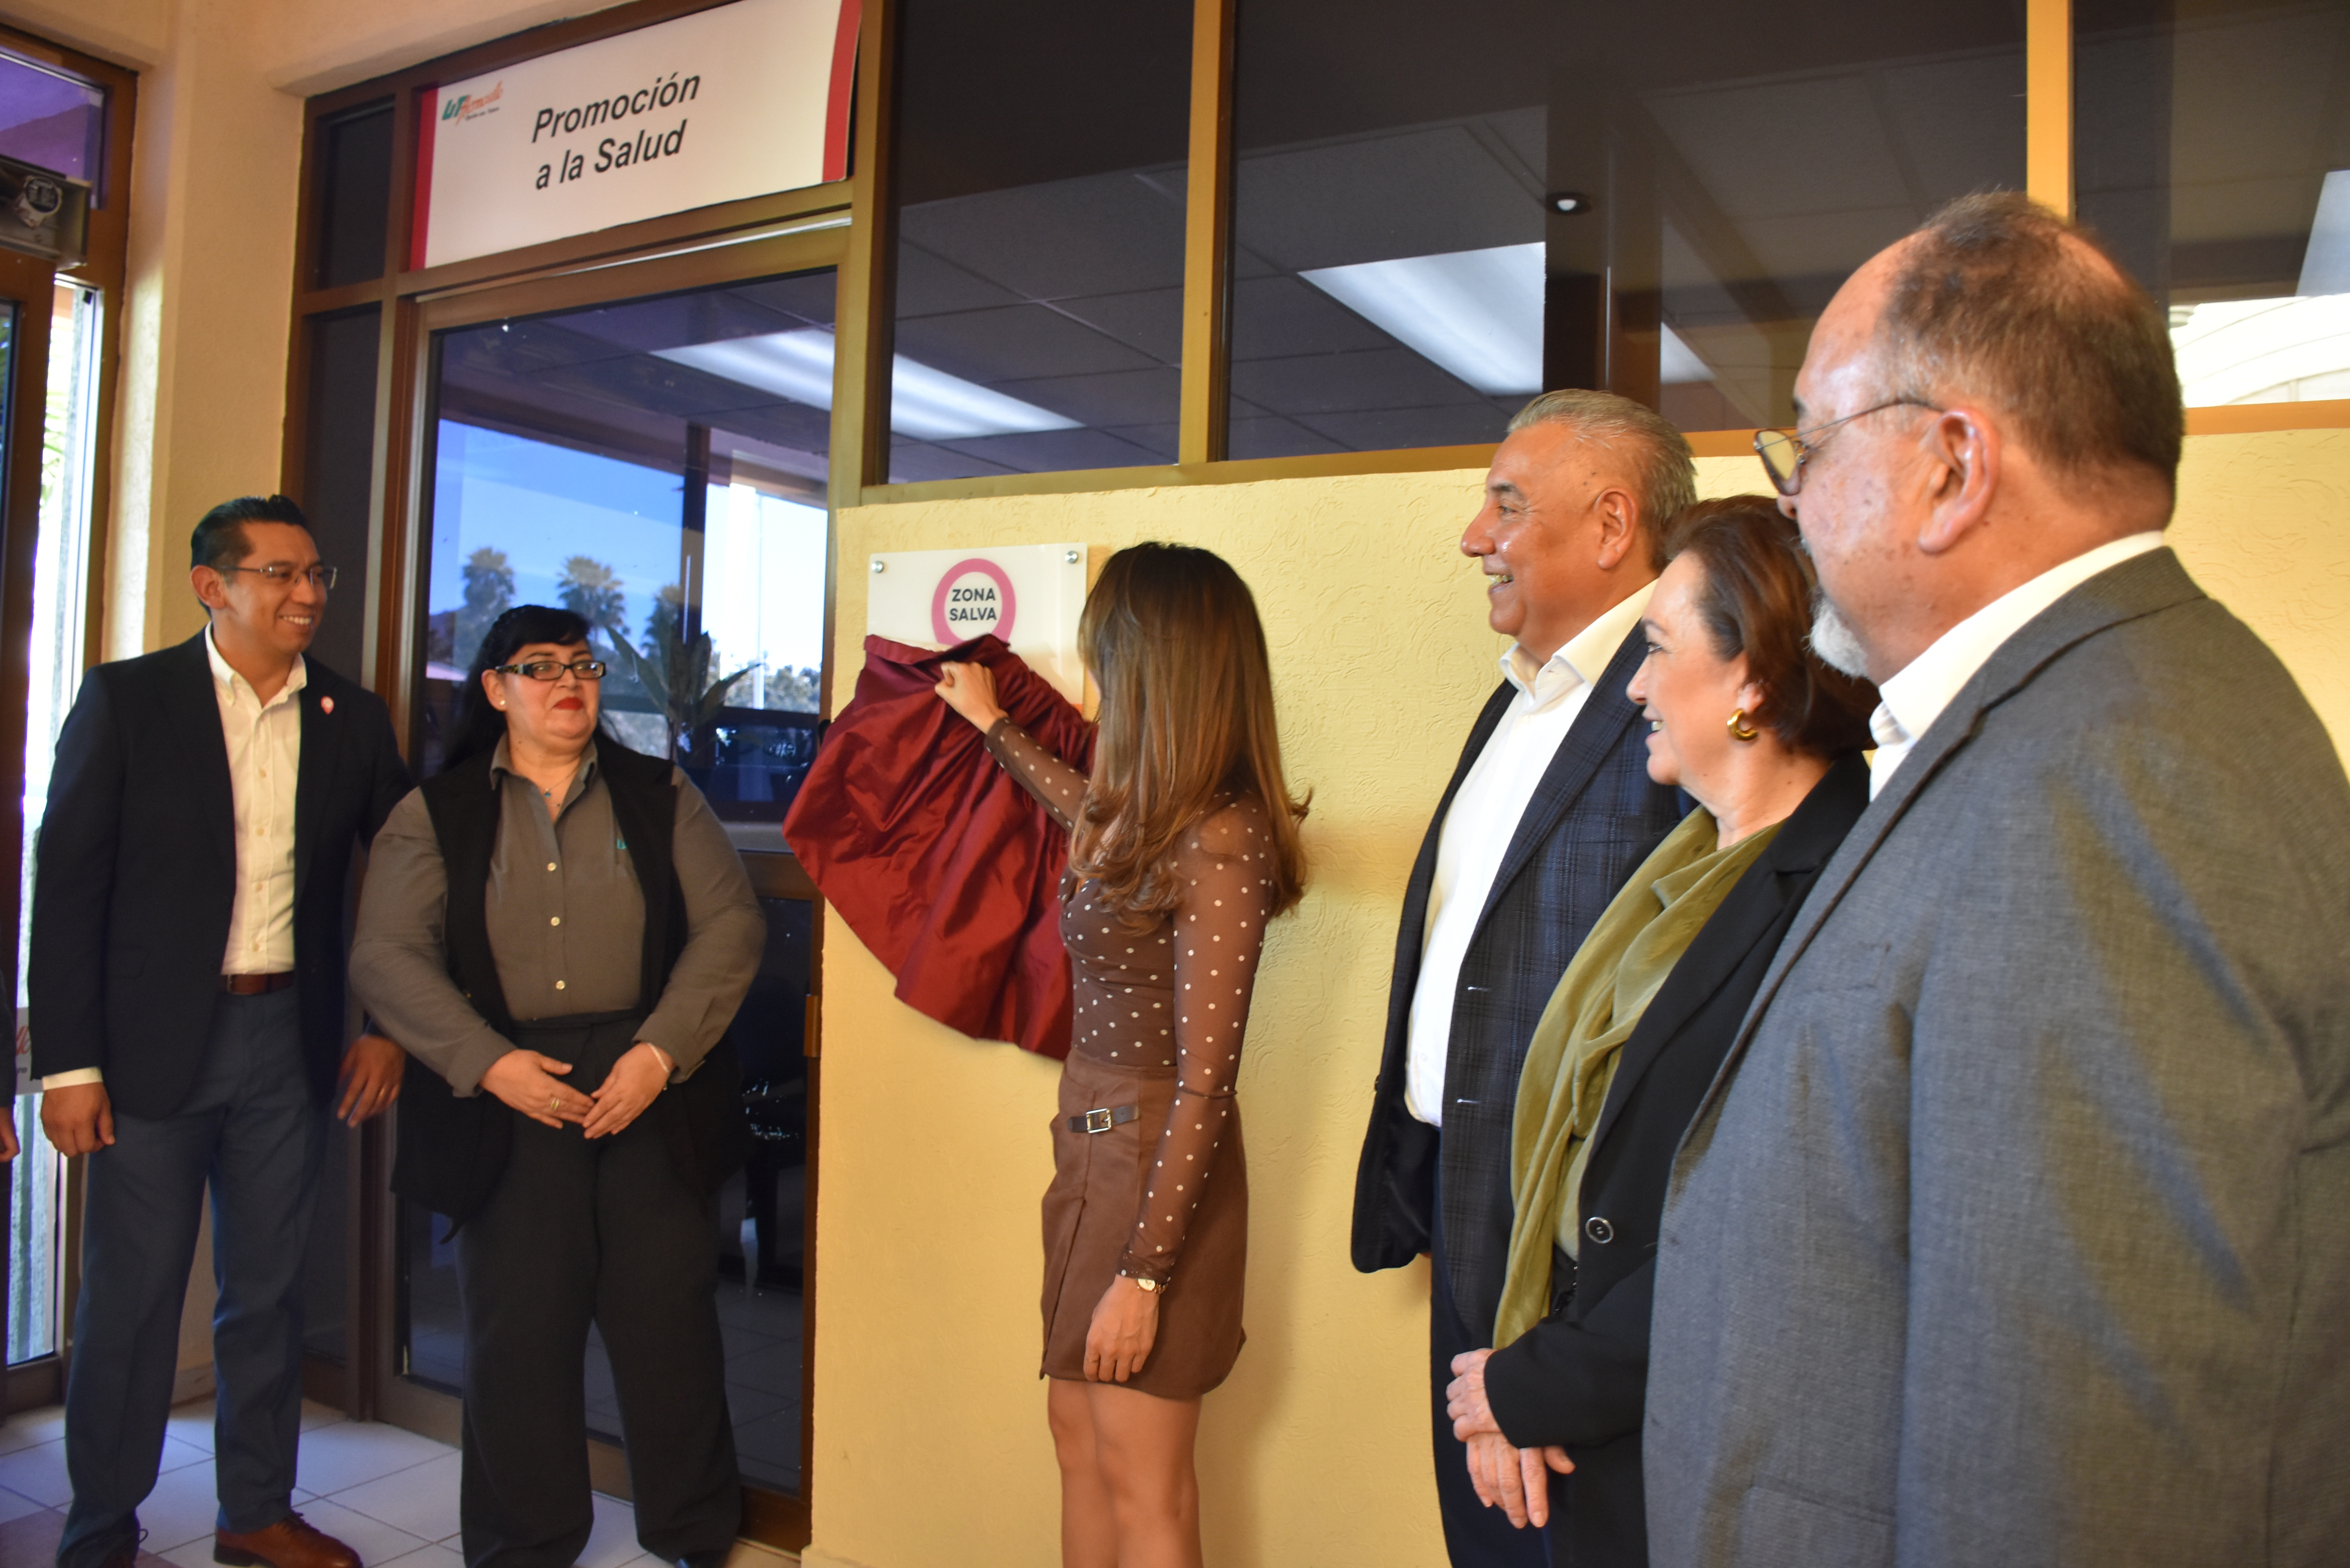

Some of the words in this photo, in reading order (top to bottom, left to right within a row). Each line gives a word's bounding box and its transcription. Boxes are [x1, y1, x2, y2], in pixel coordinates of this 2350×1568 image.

[532, 71, 700, 143] Promoción
[536, 164, 551, 190] a
[560, 149, 584, 183] la
[594, 119, 687, 173] Salud
[950, 607, 997, 621] SALVA
[952, 587, 996, 602] ZONA
